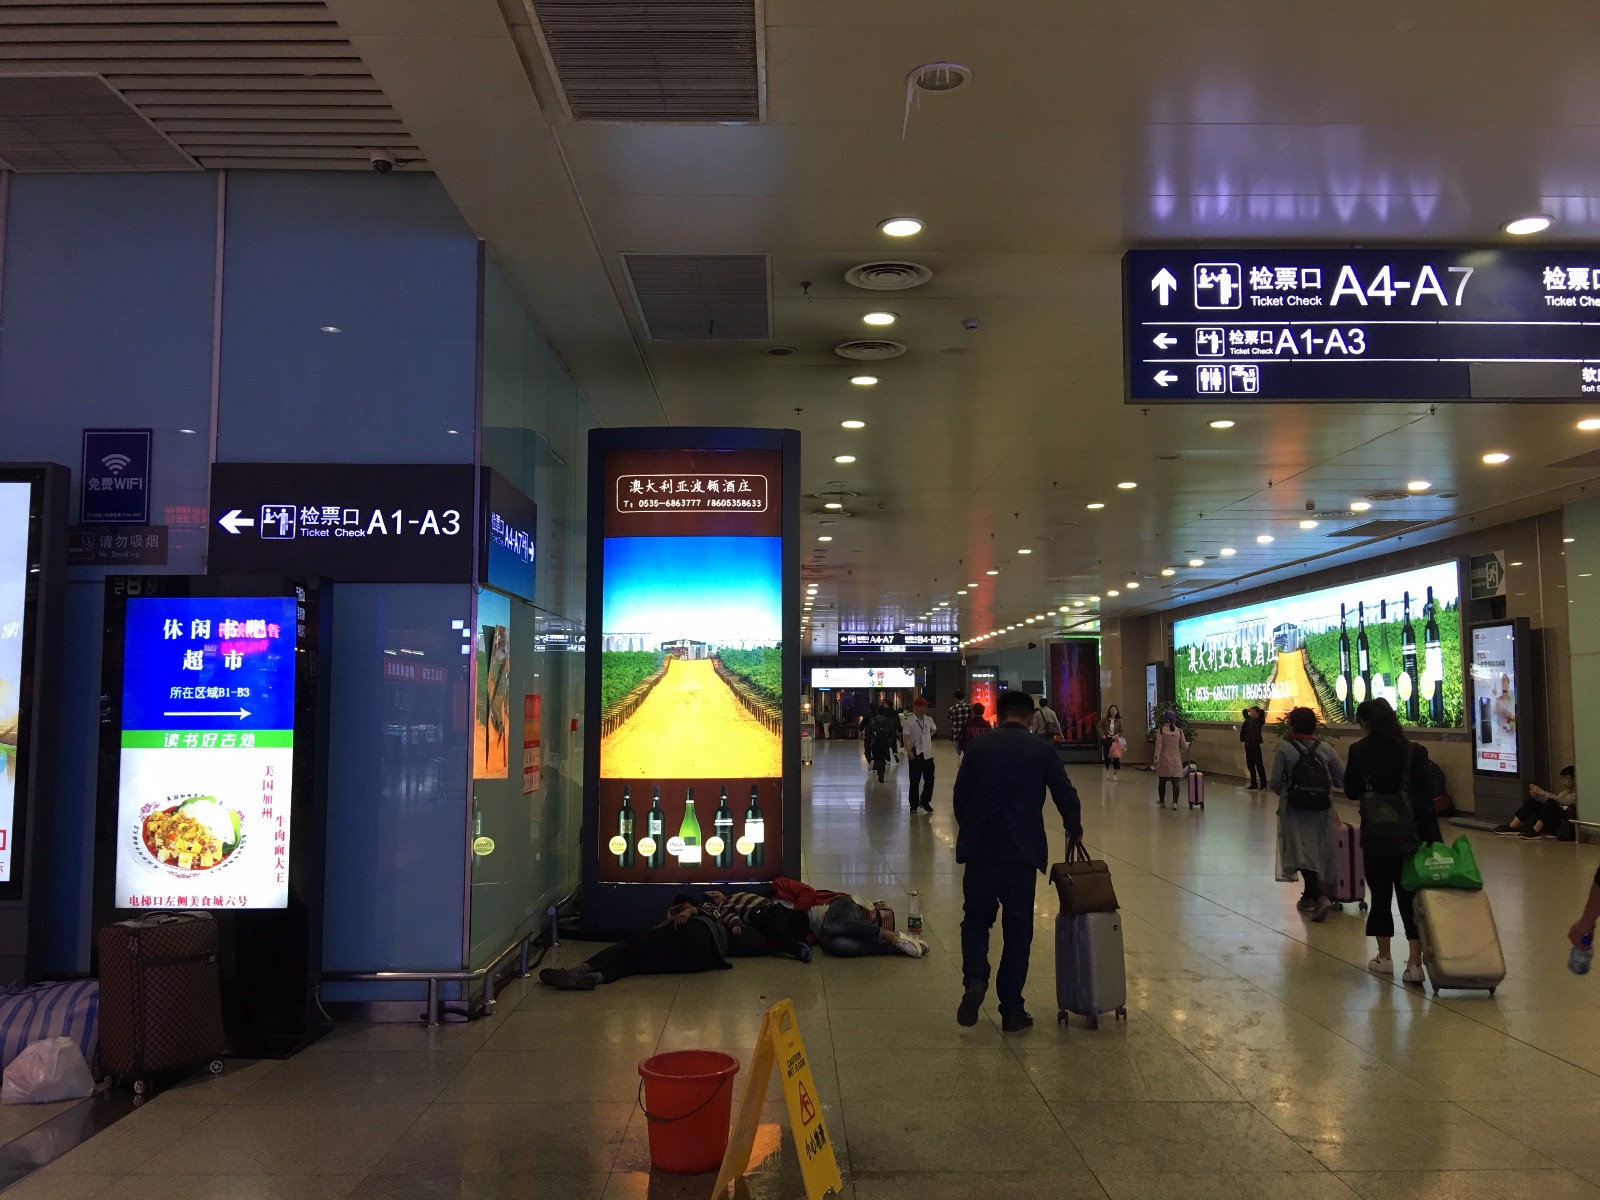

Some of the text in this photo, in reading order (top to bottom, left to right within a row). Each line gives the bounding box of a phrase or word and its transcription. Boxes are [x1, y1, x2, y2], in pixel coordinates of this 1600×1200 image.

[1249, 266, 1322, 290] 检票口
[1329, 265, 1474, 306] A4-A7
[1250, 295, 1322, 306] Ticket Check
[1544, 295, 1577, 306] Ticket
[1229, 330, 1274, 345] 检票口
[1275, 328, 1366, 355] A1-A3
[1581, 367, 1600, 383] 软
[88, 477, 143, 491] 免费WIFI
[638, 499, 701, 508] 0535-6863777
[706, 499, 762, 508] 18605358633
[300, 506, 359, 526] 检票口
[366, 509, 461, 536] A1-A3
[300, 528, 365, 537] Ticket Check
[99, 534, 159, 549] 请勿吸烟
[182, 650, 244, 671] 超市
[170, 687, 250, 699] 所在区域B1-B3
[164, 733, 256, 748] 读书好去处
[262, 765, 275, 819] 美国加州
[274, 815, 287, 883] 牛肉面大王
[129, 895, 248, 907] 电梯口左侧美食城六号
